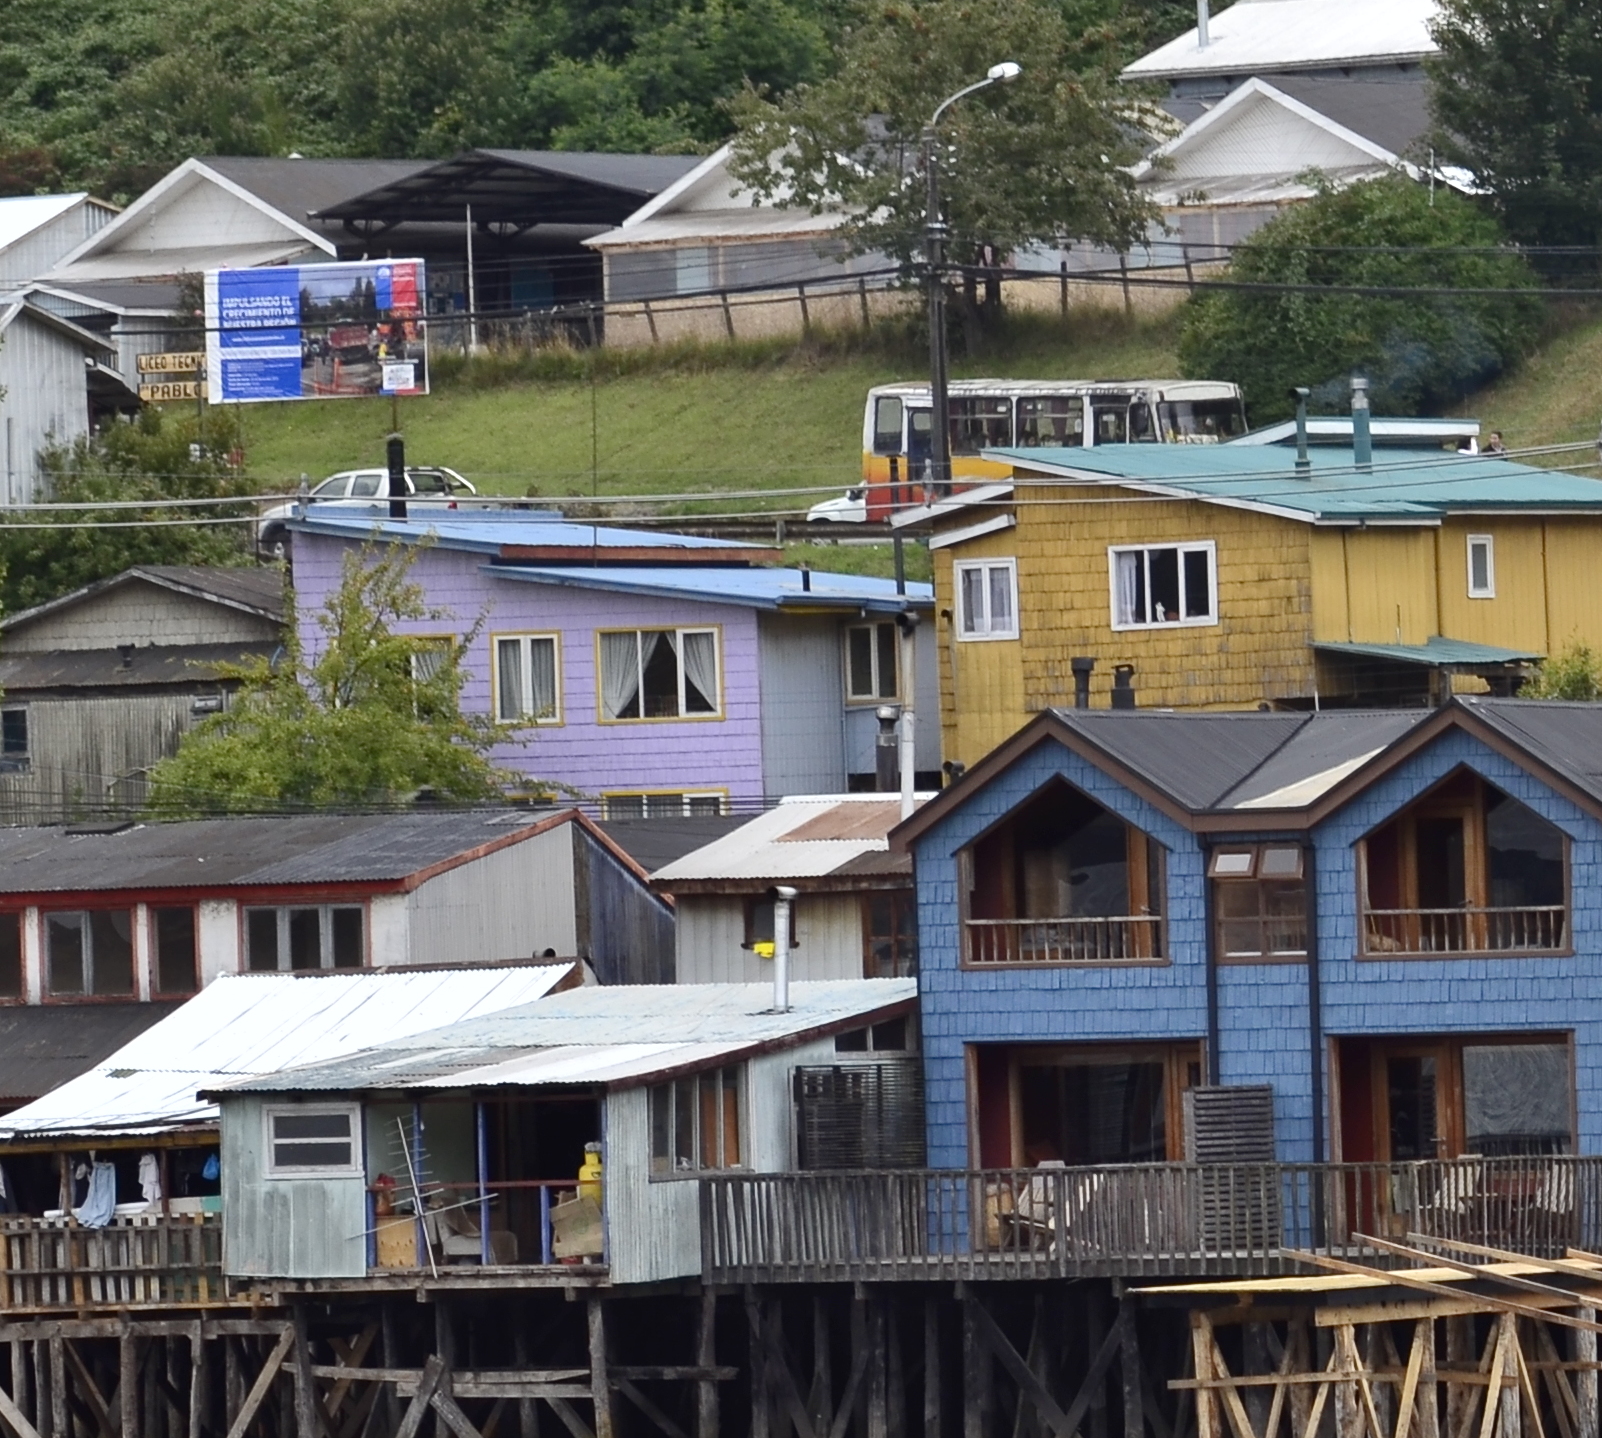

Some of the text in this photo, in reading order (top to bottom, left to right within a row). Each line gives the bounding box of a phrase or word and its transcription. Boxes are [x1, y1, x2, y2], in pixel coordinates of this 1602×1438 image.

[223, 295, 293, 308] IMPULSANDO EL
[223, 307, 295, 319] CRECIMIENTO DE
[139, 356, 167, 370] LICEO
